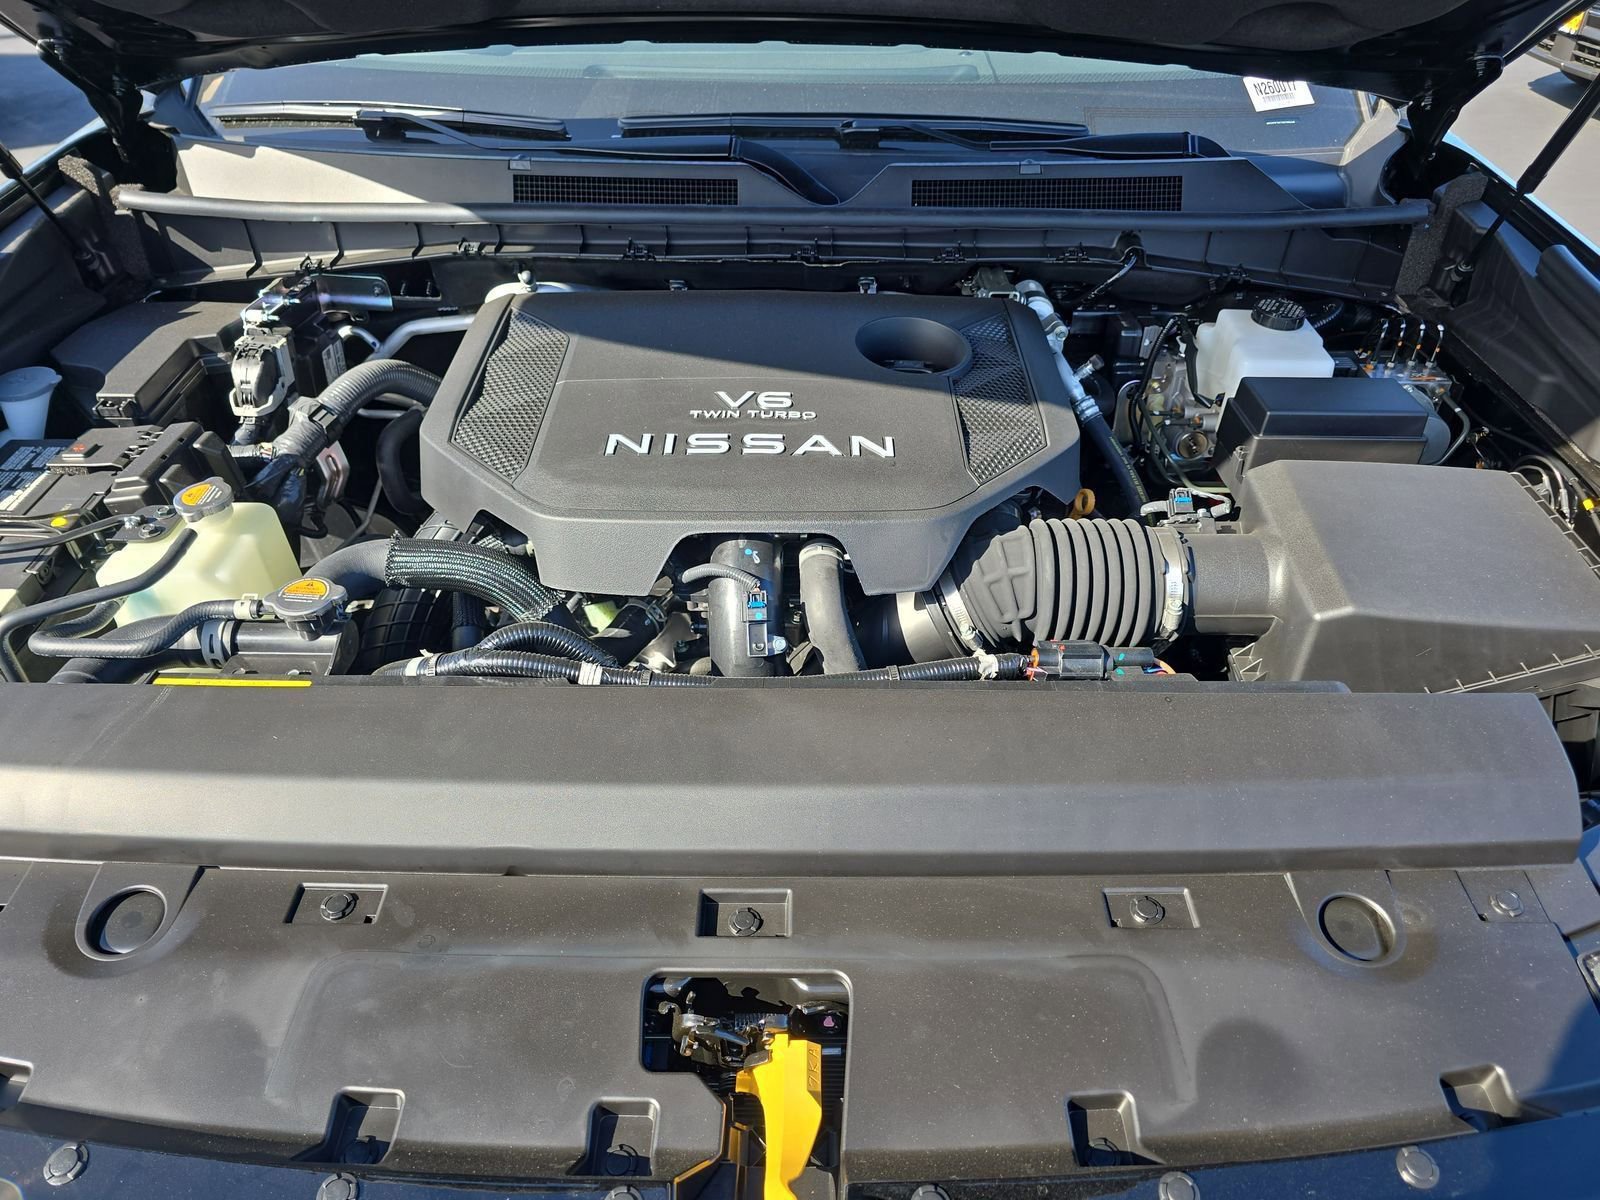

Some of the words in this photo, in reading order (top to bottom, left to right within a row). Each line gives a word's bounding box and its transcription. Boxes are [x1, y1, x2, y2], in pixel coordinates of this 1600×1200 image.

[714, 390, 794, 410] V6
[689, 409, 741, 419] TWIN
[747, 409, 818, 420] TURBO
[604, 433, 896, 458] NISSAN
